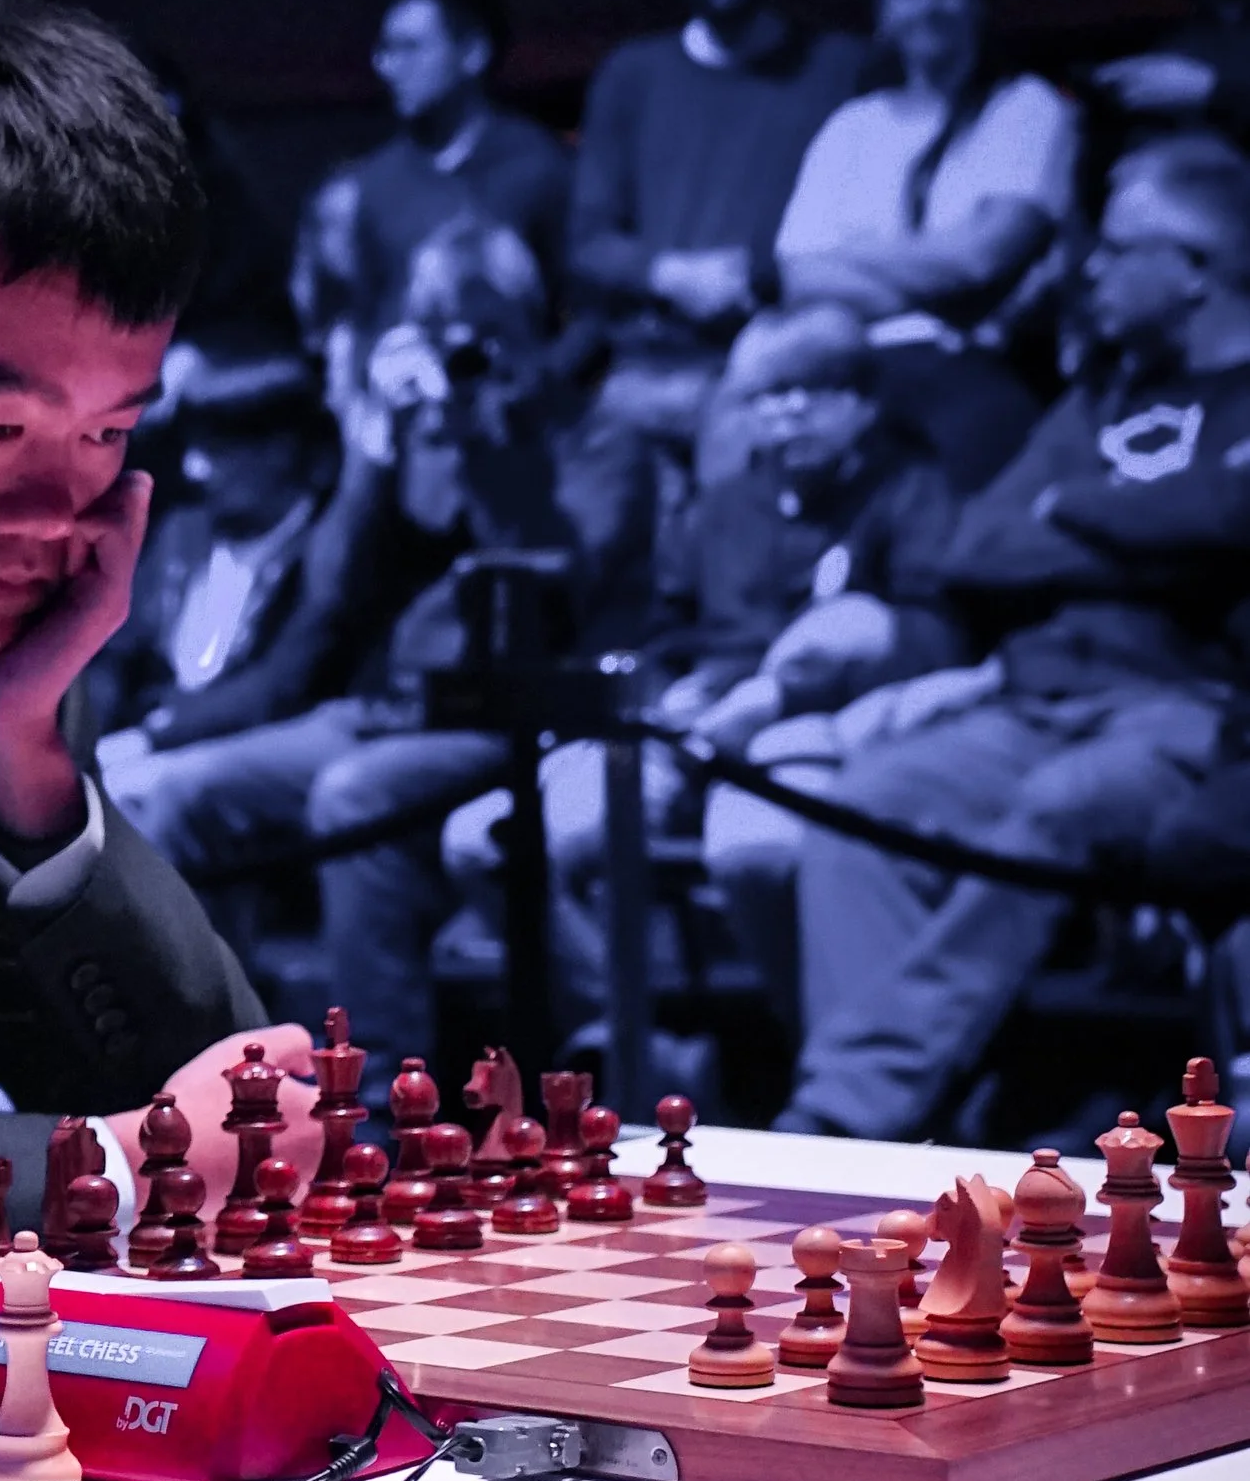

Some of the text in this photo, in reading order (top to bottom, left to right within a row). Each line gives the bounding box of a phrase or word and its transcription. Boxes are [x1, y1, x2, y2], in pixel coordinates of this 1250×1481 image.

[78, 1338, 142, 1364] CHESS
[116, 1395, 179, 1435] by DGT
